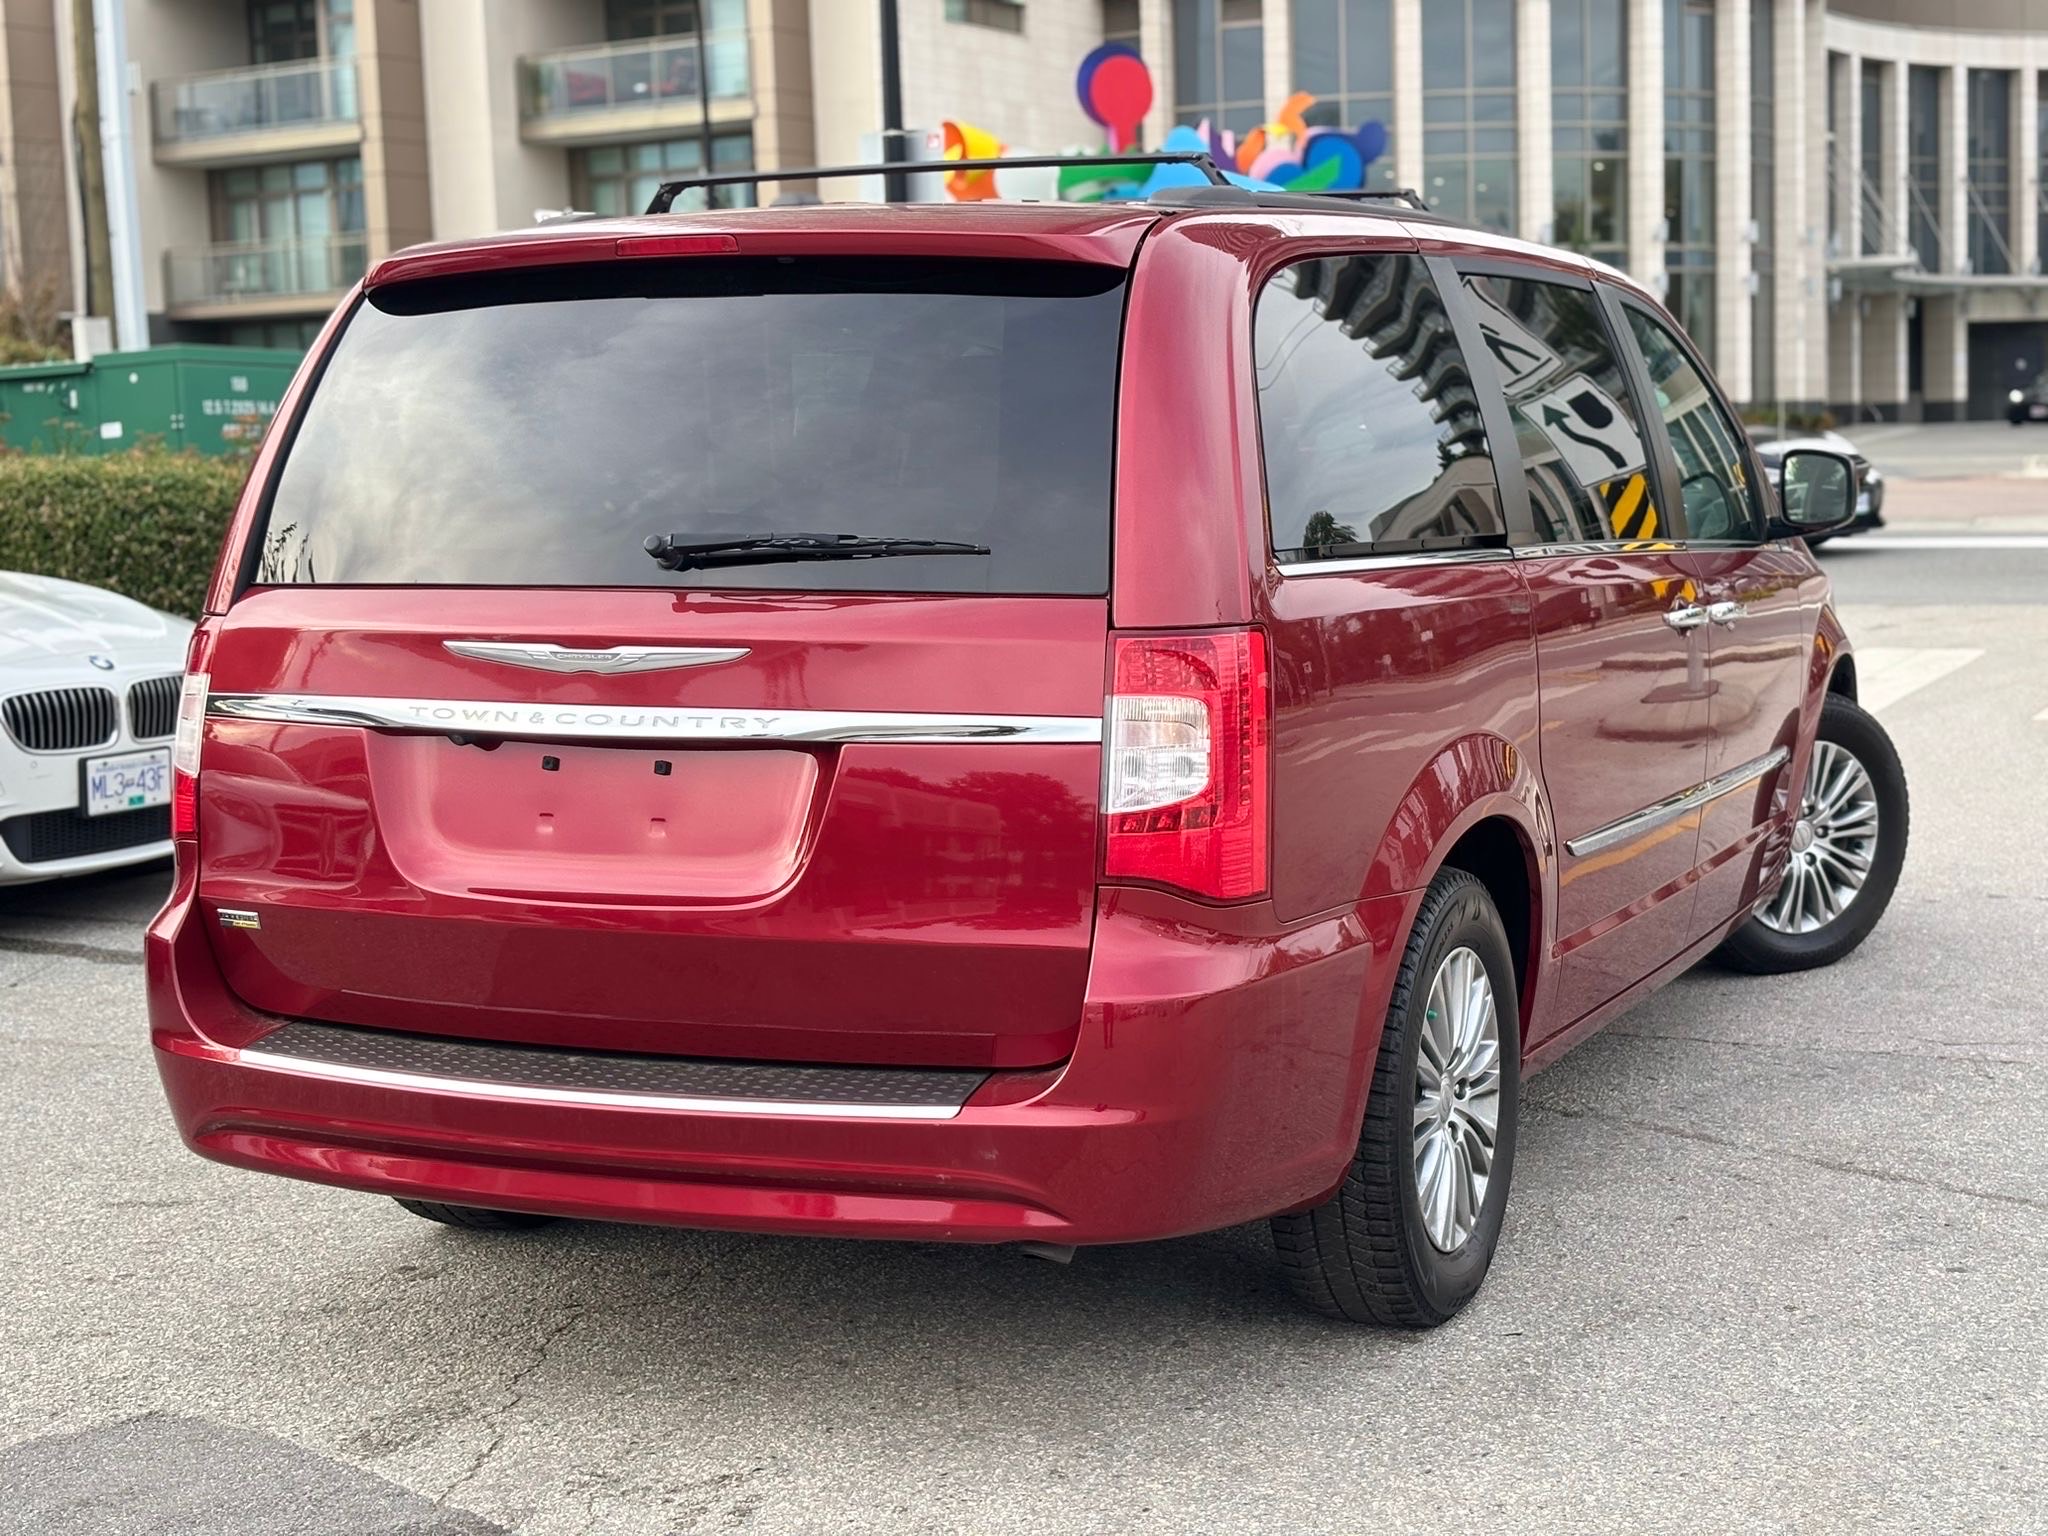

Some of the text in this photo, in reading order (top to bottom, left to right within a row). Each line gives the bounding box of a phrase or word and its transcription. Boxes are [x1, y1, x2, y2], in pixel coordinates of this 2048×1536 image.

[408, 706, 781, 730] TOWN & COUNTRY
